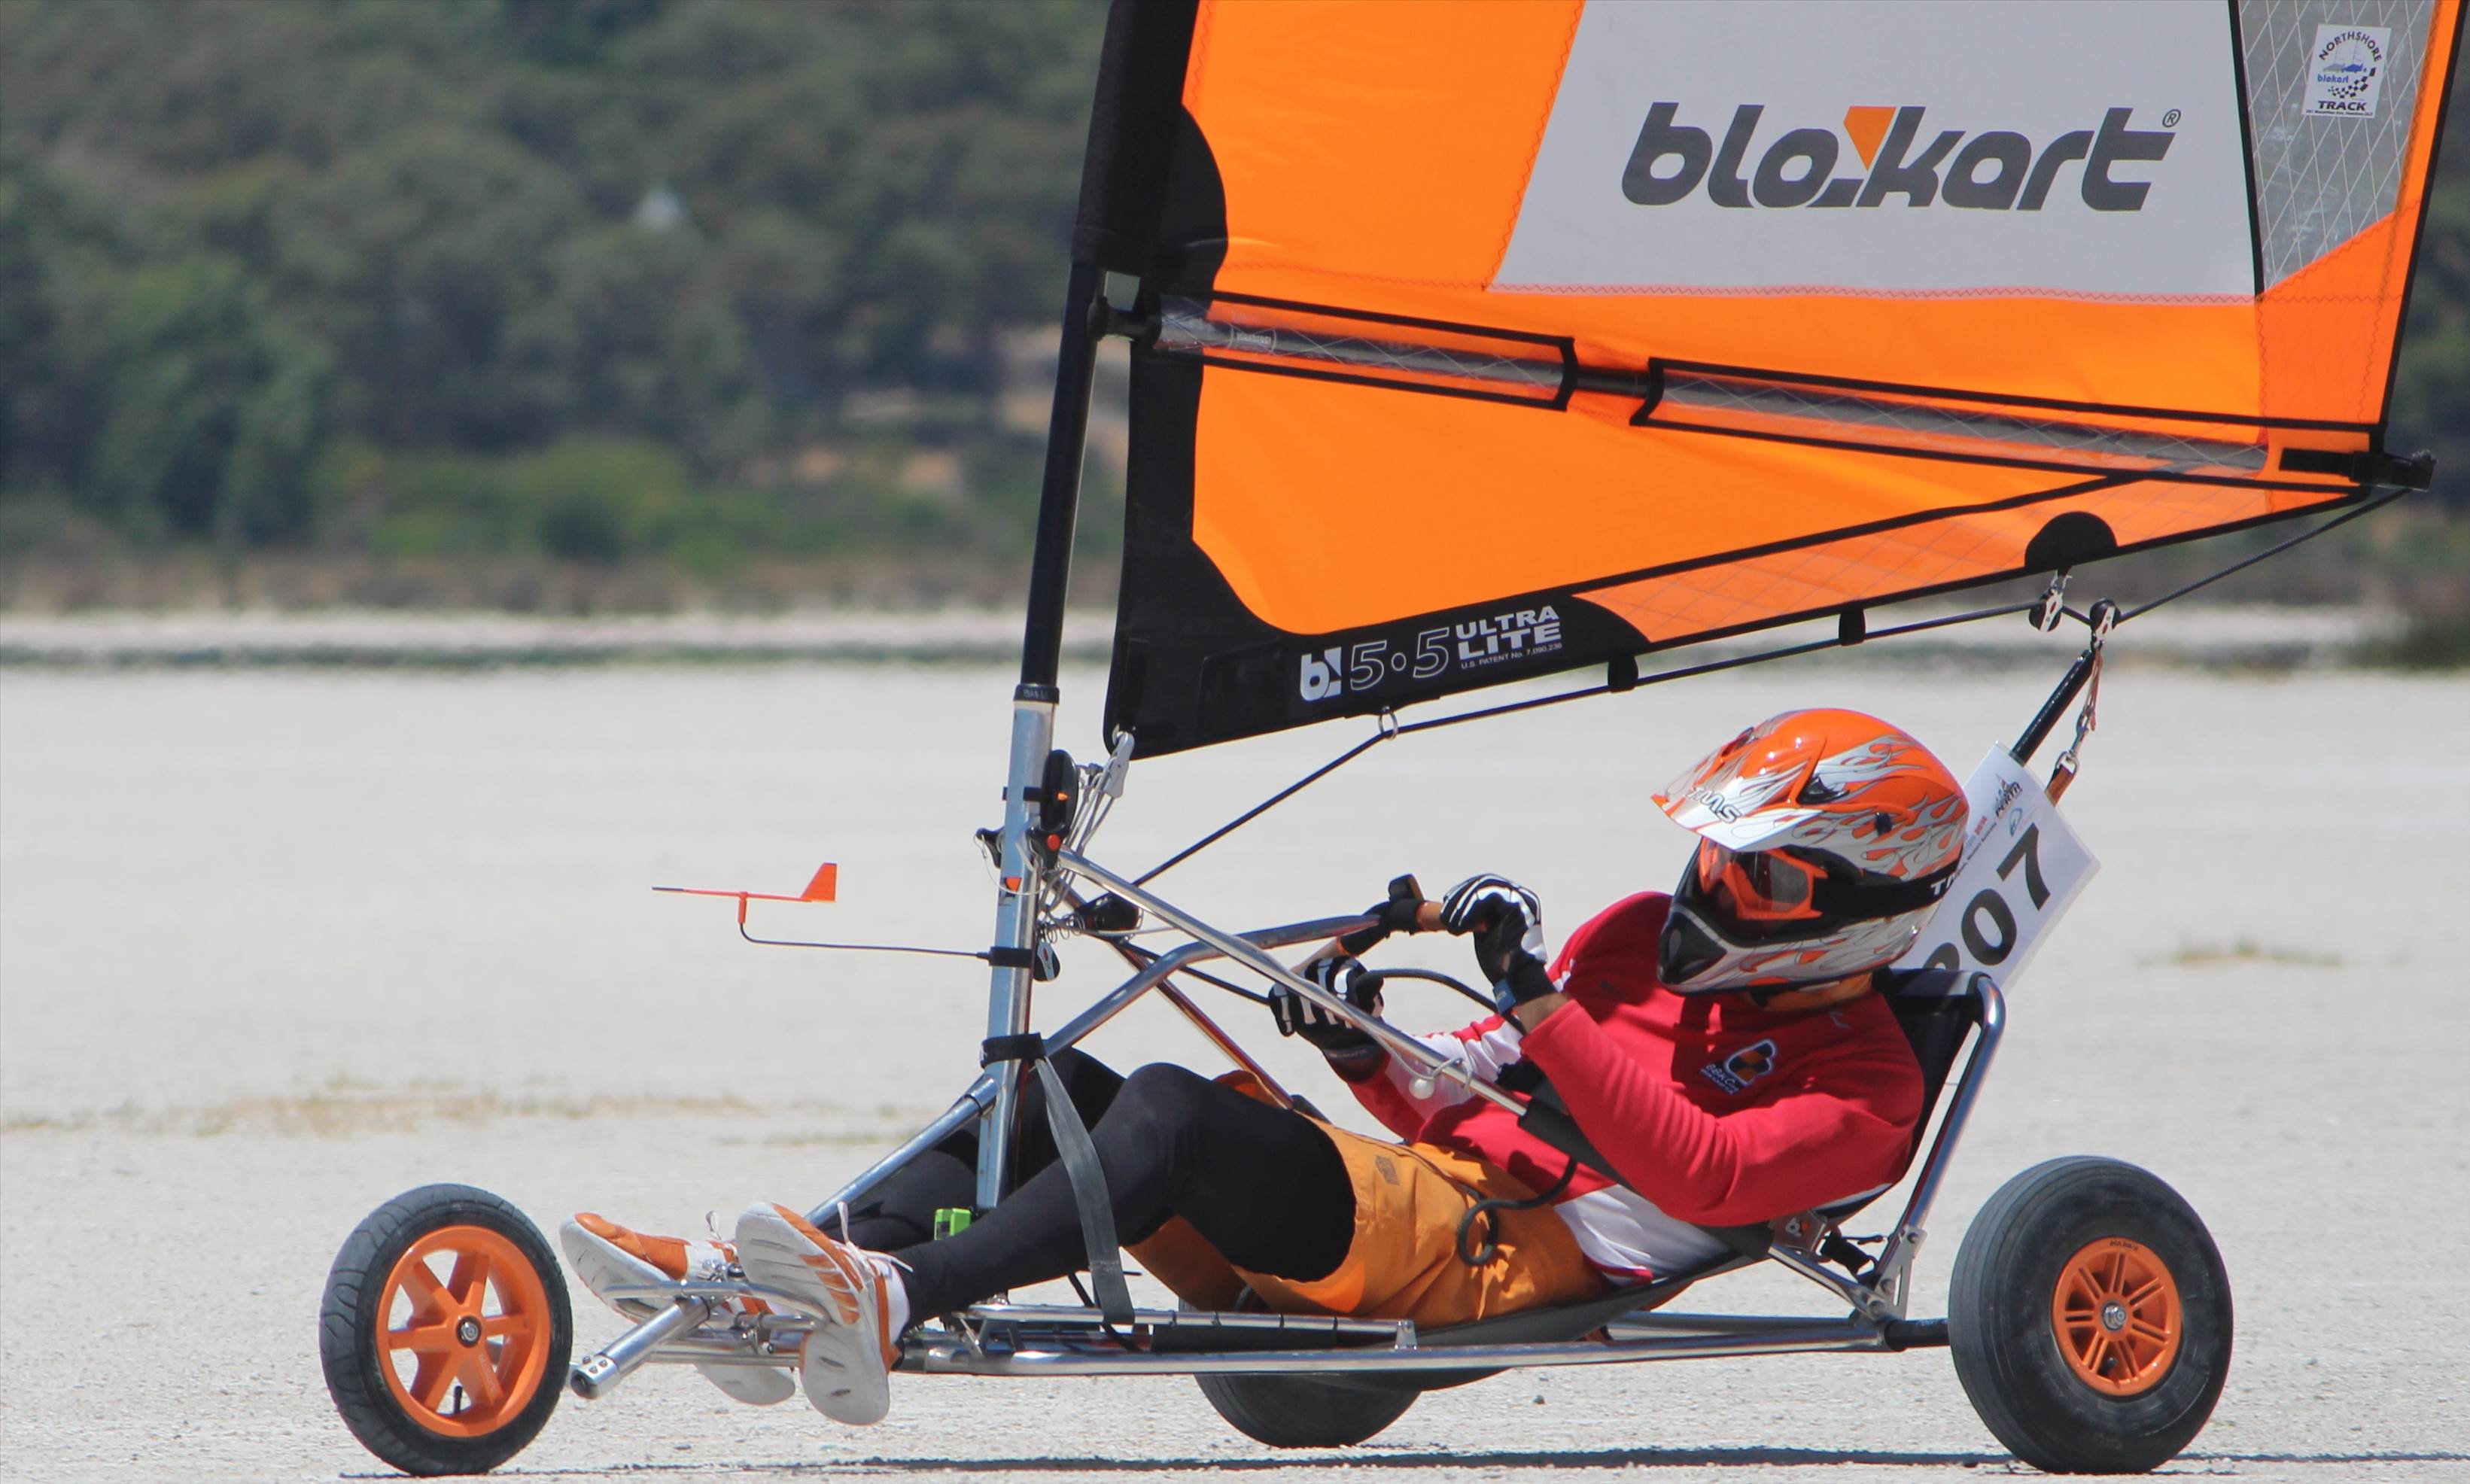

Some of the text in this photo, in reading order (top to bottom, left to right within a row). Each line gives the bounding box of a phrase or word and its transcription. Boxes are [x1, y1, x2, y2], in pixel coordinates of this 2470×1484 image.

[2319, 31, 2382, 62] NORTHSHORE
[2318, 75, 2349, 83] blokart
[2318, 100, 2367, 111] TRACK
[1455, 605, 1559, 640] ULTRA
[1458, 621, 1562, 661] LITE
[1479, 653, 1510, 665] PATENT
